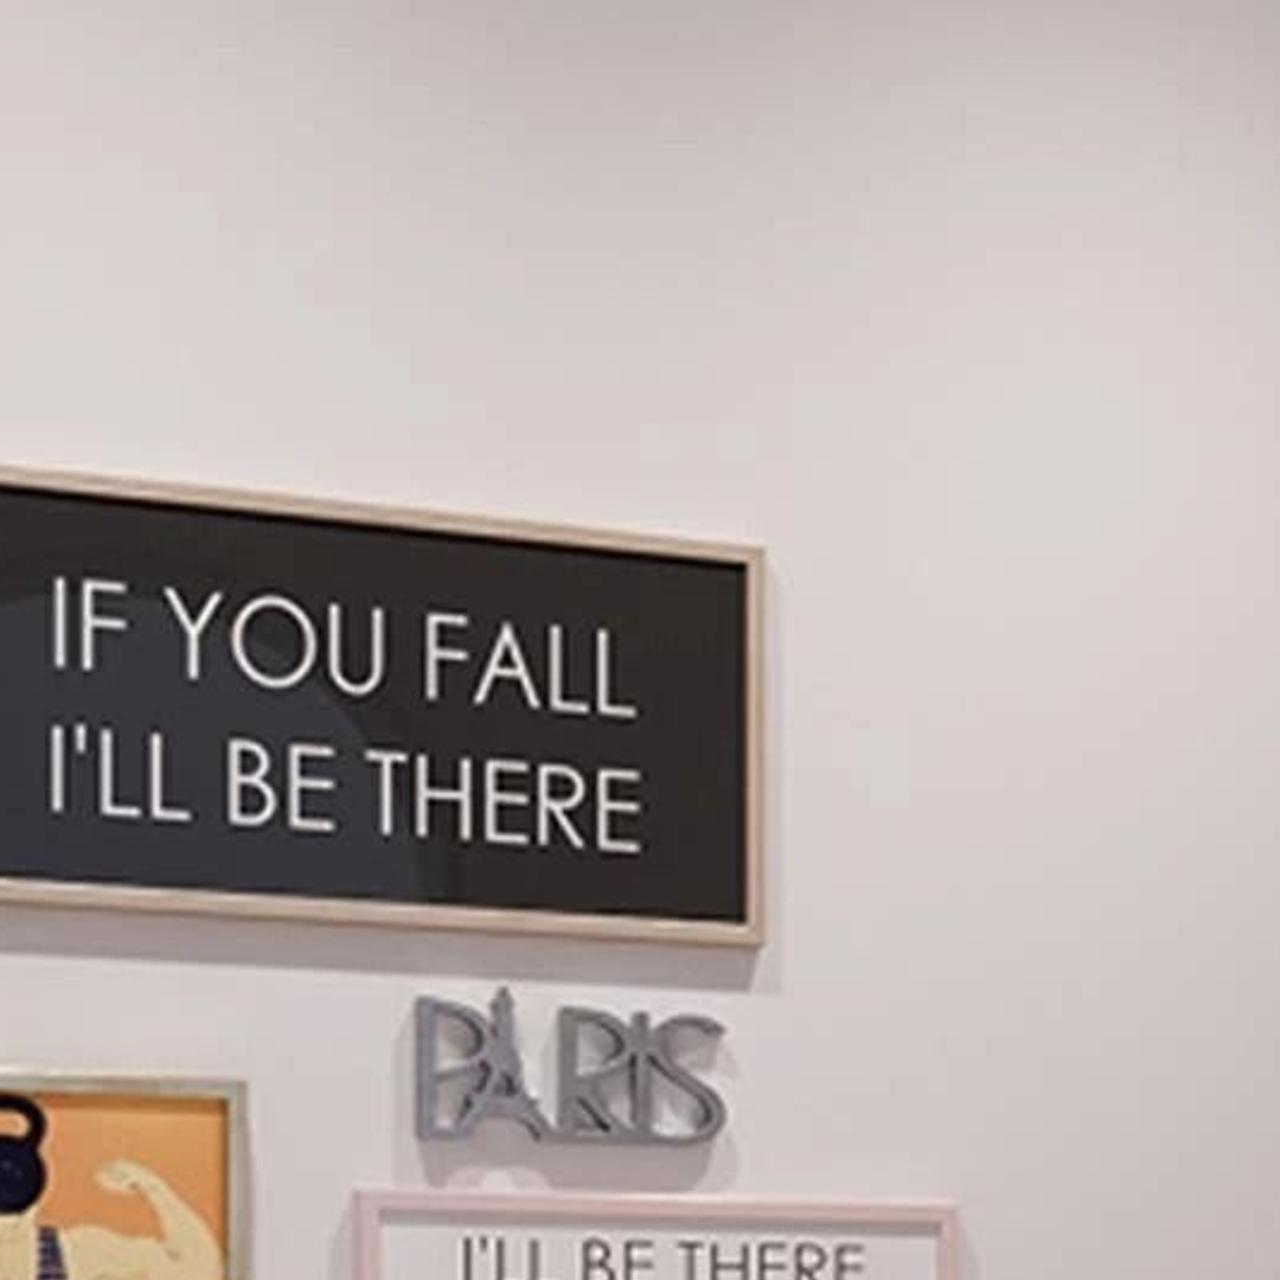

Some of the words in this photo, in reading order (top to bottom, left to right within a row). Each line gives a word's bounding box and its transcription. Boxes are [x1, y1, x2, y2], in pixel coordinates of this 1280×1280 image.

[53, 575, 128, 671] IF
[163, 586, 384, 696] YOU
[425, 612, 638, 718] FALL
[50, 722, 192, 822] I'LL
[227, 737, 336, 832] BE
[364, 748, 641, 854] THERE
[414, 987, 727, 1149] PARIS
